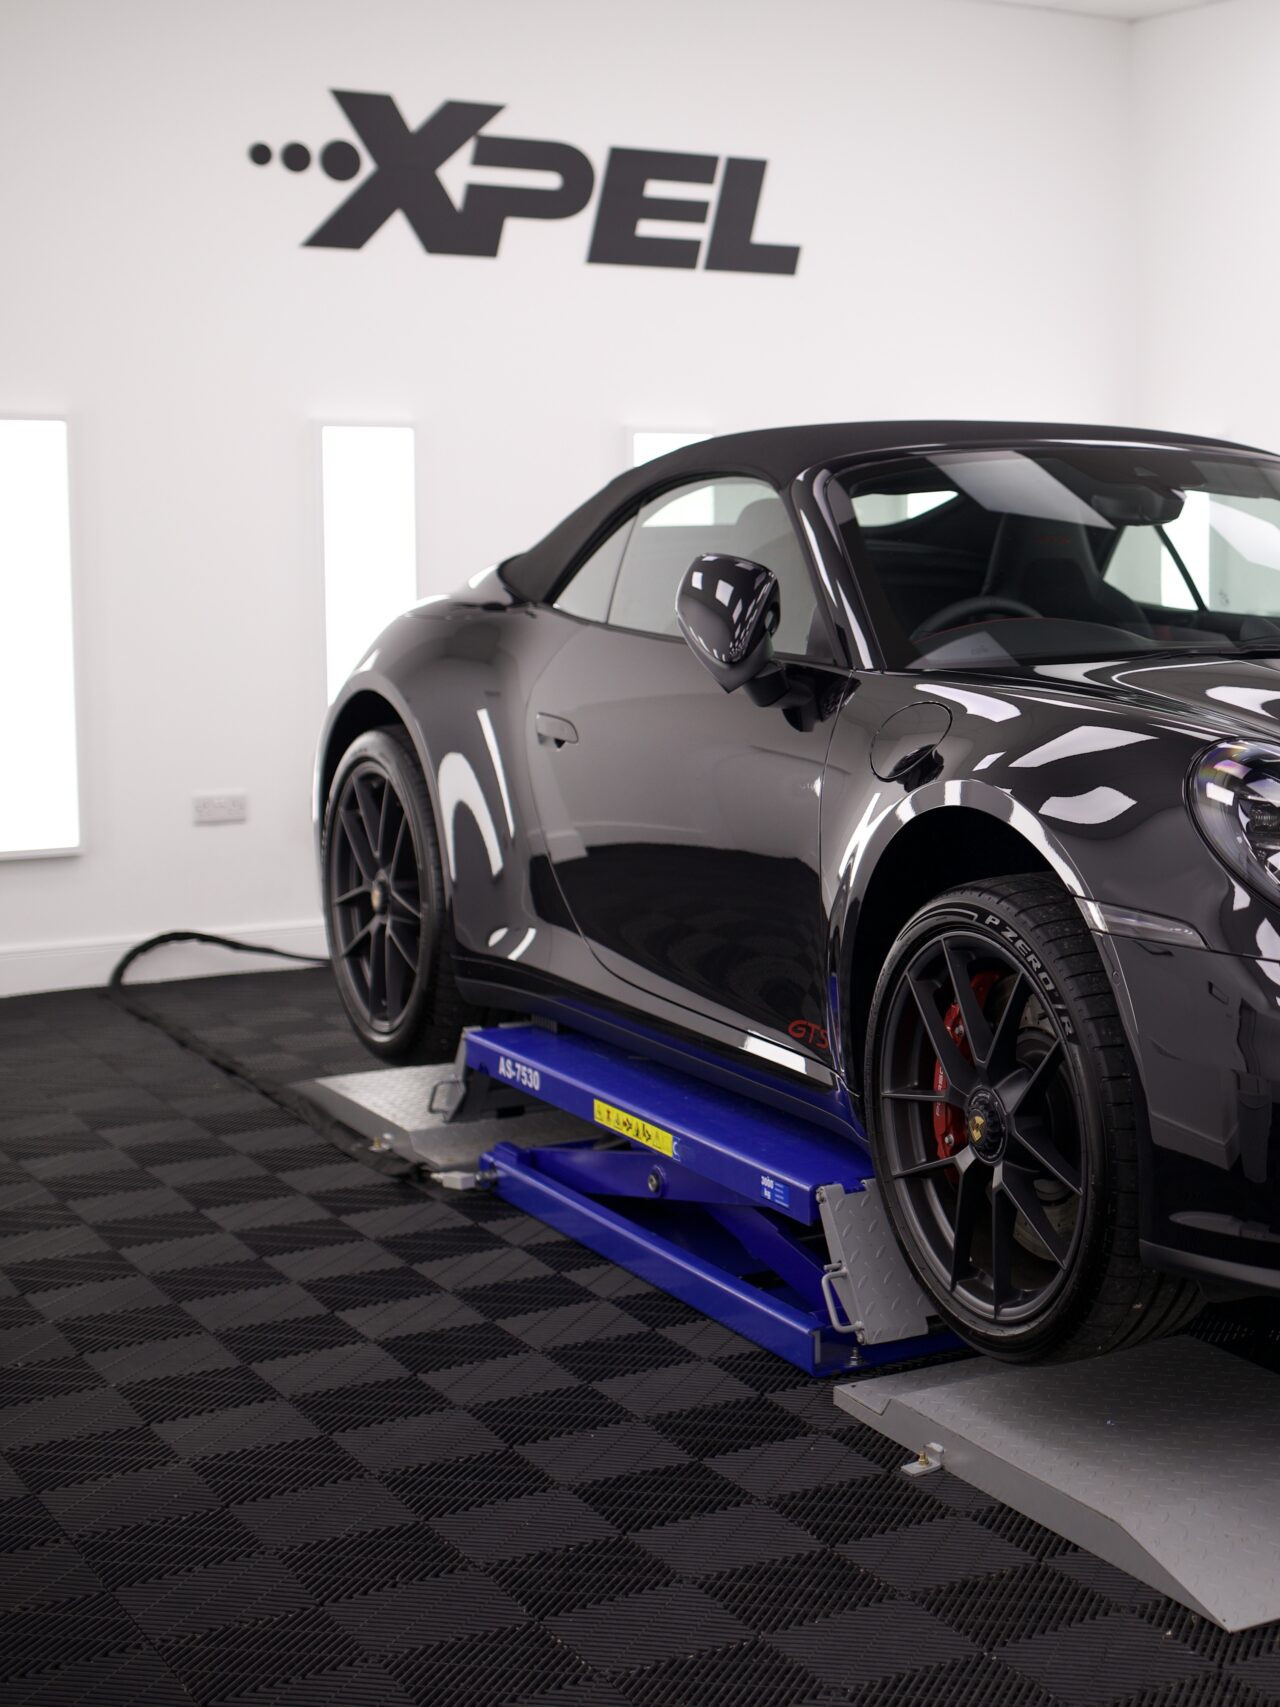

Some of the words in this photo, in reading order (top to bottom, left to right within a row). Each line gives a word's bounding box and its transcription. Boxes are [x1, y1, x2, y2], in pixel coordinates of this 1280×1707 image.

[299, 87, 803, 276] XPEL
[985, 914, 1001, 926] P
[1001, 926, 1056, 992] ZERO
[788, 1019, 830, 1050] GTS
[498, 1055, 541, 1092] AS-7530
